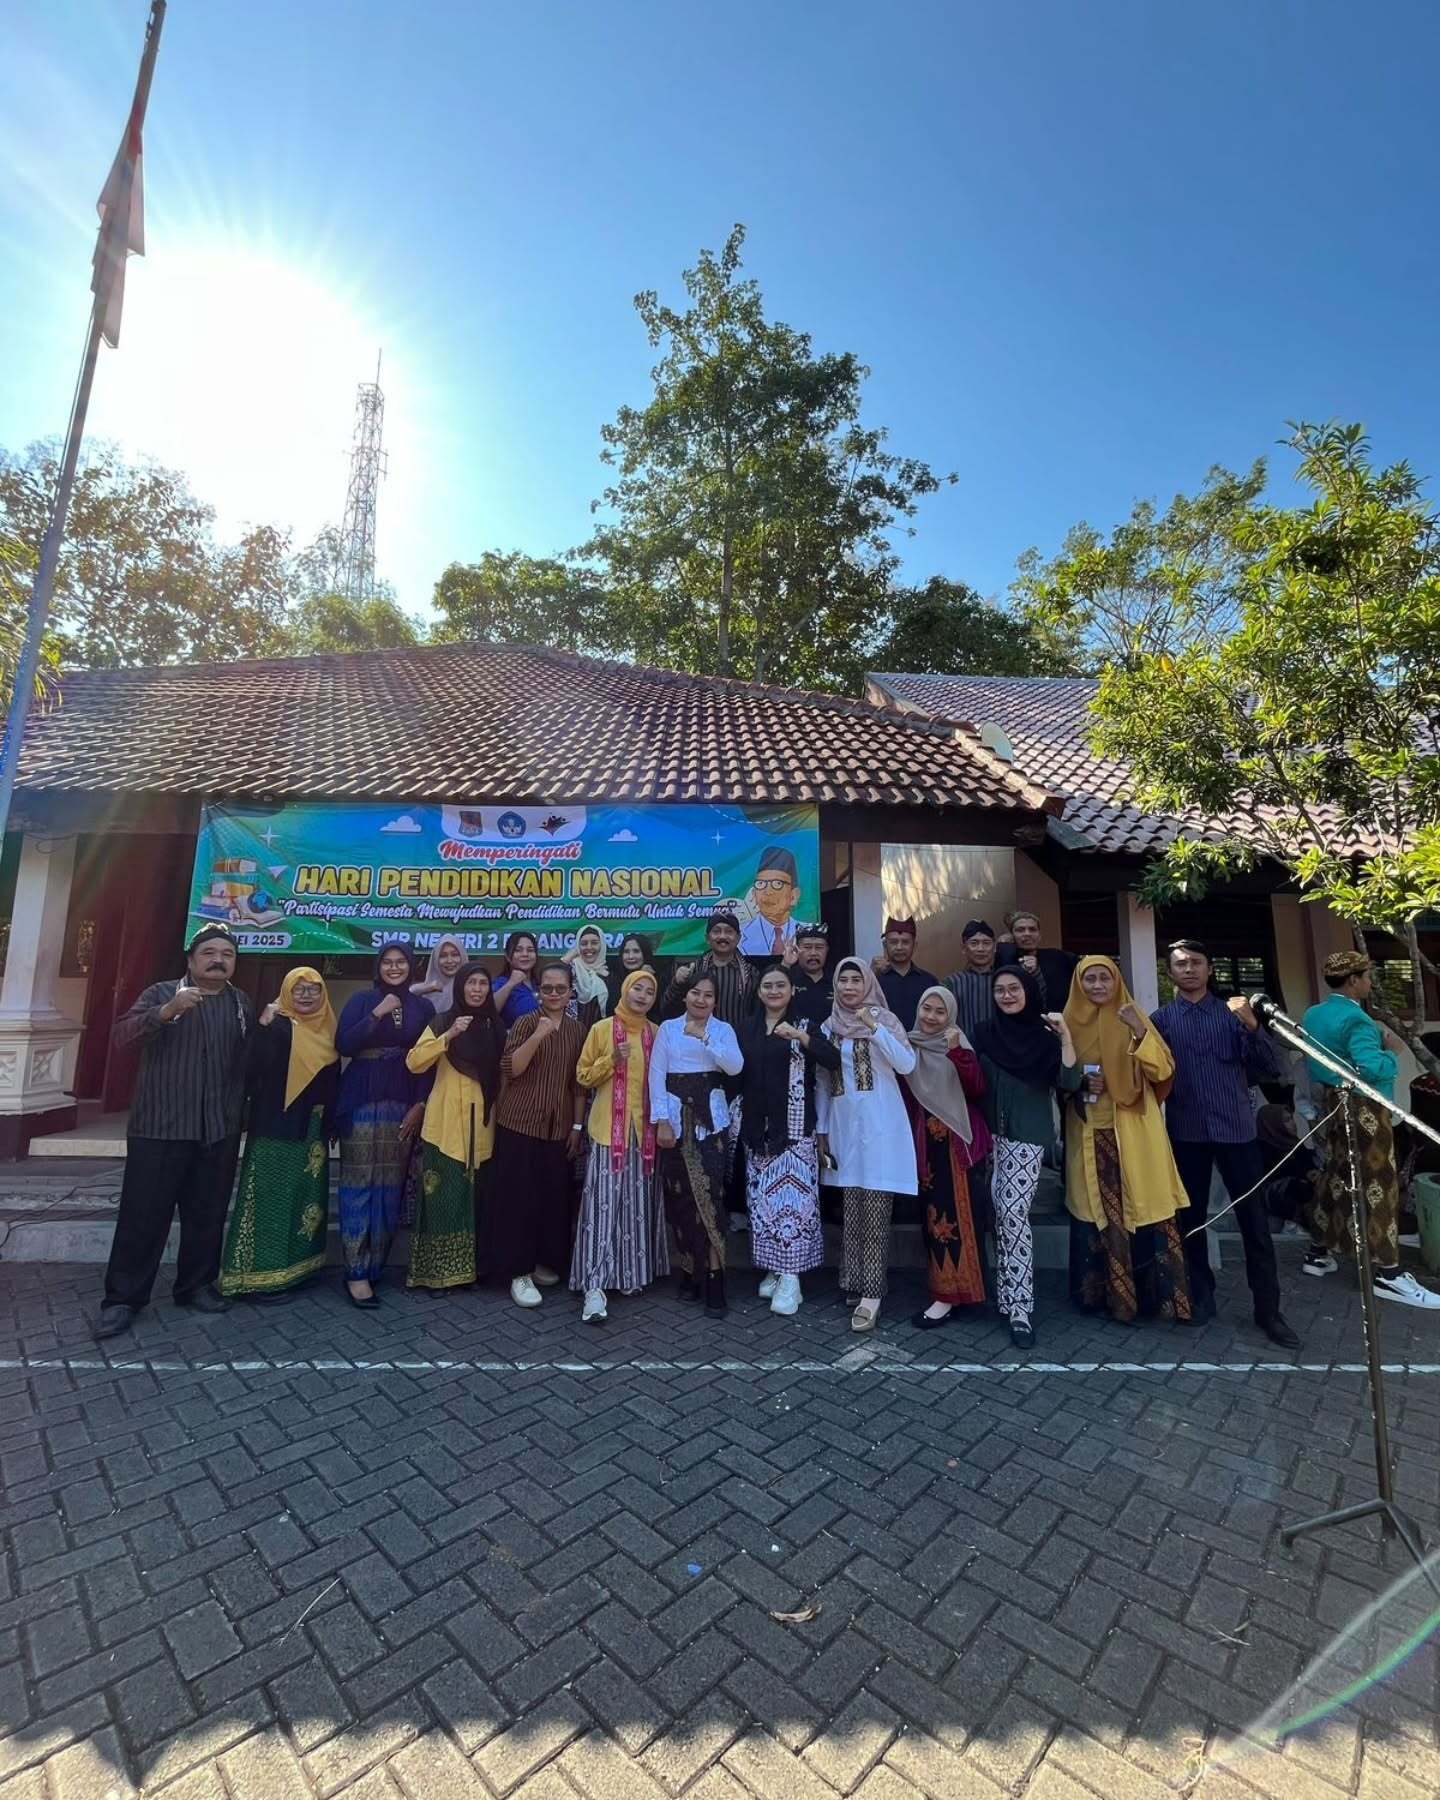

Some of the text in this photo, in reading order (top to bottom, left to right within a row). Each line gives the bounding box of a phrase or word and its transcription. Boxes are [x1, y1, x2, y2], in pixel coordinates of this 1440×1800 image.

[439, 839, 582, 866] Memperingati
[293, 865, 721, 899] HARI PENDIDIKAN NASIONAL
[279, 899, 358, 919] "Partisipasi
[360, 902, 413, 918] Semesta
[416, 902, 503, 923] Mewujudkan
[505, 903, 581, 919] Pendidikan
[584, 903, 640, 918] Bermutu
[644, 903, 685, 918] Untuk
[252, 935, 284, 945] 2025
[414, 932, 482, 949] NERI
[487, 933, 498, 949] 2
